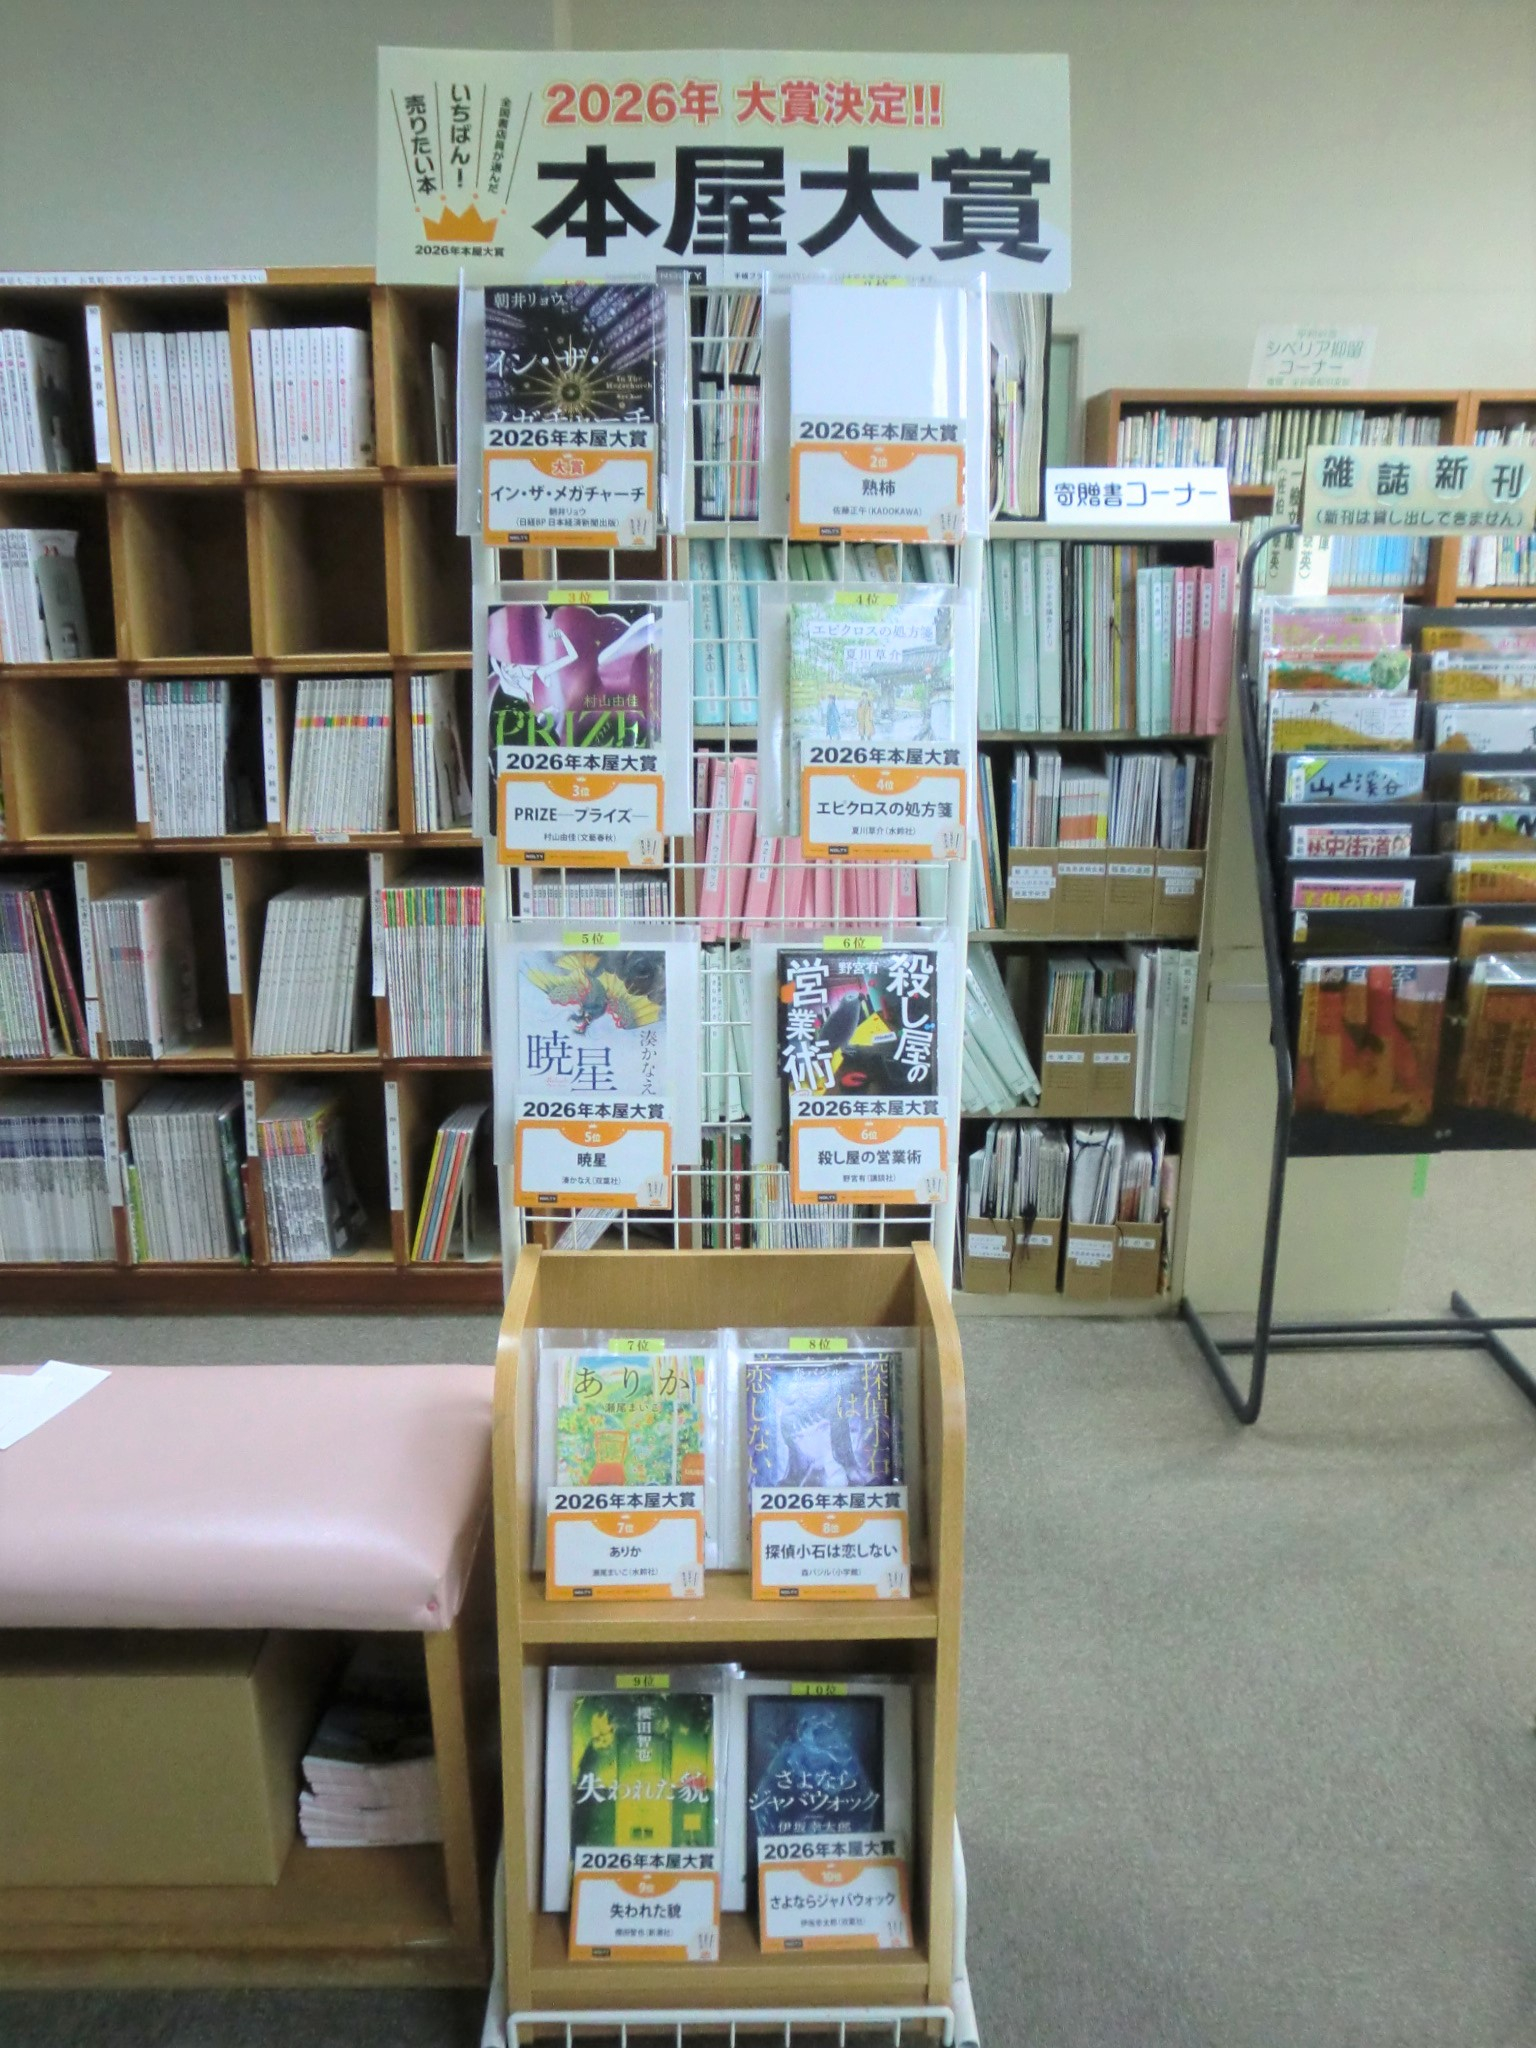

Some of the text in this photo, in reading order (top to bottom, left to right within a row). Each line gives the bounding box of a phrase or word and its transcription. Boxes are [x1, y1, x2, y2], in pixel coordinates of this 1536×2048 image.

[546, 80, 720, 125] 2026年
[404, 93, 437, 196] 売りたい本
[531, 144, 1053, 264] 本屋大賞
[415, 245, 505, 257] 2026年本屋大賞
[494, 291, 564, 308] 朝井リョウ
[1266, 340, 1364, 359] シベリア抑留
[1279, 359, 1343, 375] コーナー
[489, 428, 648, 448] 2026年本屋大賞
[799, 421, 959, 442] 2026年本屋大賞
[552, 460, 586, 475] 大賞
[869, 456, 888, 468] 2位
[1322, 455, 1524, 499] 雑誌新刊
[490, 485, 646, 503] イン・ザ・メガチャーチ
[862, 478, 896, 497] 熟柿
[1054, 481, 1218, 507] 寄贈書コーナー
[856, 594, 879, 605] 4位
[811, 623, 935, 640] エピクロスの処方箋
[845, 649, 903, 662] 夏川草介
[584, 694, 639, 708] 村山由佳
[493, 709, 649, 748] PRIZE
[506, 753, 658, 772] 2026年本屋大賞
[809, 746, 961, 767] 2026年本屋大賞
[571, 784, 591, 797] 3位
[876, 778, 894, 790] 4位
[816, 801, 953, 818] エピクロスの処方箋
[581, 933, 605, 946] 5位
[843, 937, 866, 949] 6位
[838, 961, 879, 975] 野宮有
[783, 957, 836, 1091] 営業術
[886, 953, 933, 1083] 殺し屋の
[527, 1029, 618, 1093] 暁星
[639, 1030, 657, 1096] 湊かなえ
[523, 1101, 664, 1120] 2026年本屋大賞
[797, 1100, 939, 1117] 2026年本屋大賞
[584, 1131, 601, 1143] 5位
[860, 1130, 878, 1141] 6位
[576, 1152, 607, 1168] 暁星
[817, 1149, 922, 1165] 殺し屋の営業術
[627, 1339, 650, 1352] 7位
[808, 1339, 831, 1350] 8位
[574, 1366, 690, 1399] ありか
[604, 1402, 660, 1414] 瀬尾まいこ
[836, 1393, 861, 1419] は
[746, 1364, 772, 1475] 恋しない
[554, 1492, 696, 1510] 2026年本屋大賞
[761, 1492, 901, 1510] 2026年本屋大賞
[617, 1523, 634, 1534] 7位
[609, 1546, 642, 1558] ありか
[764, 1543, 898, 1560] 探偵小石は恋しない
[633, 1675, 655, 1688] 9位
[804, 1684, 837, 1696] 10位
[577, 1771, 710, 1805] 失われた貌
[775, 1769, 857, 1790] さよなら
[748, 1790, 881, 1813] ジャバウォック
[778, 1820, 852, 1833] 伊坂幸太郎
[763, 1840, 896, 1860] 2026年本屋大賞
[582, 1853, 715, 1869] 2026年本屋大賞
[770, 1891, 896, 1911] さよならジャバウォック
[609, 1902, 682, 1919] 失われた貌
